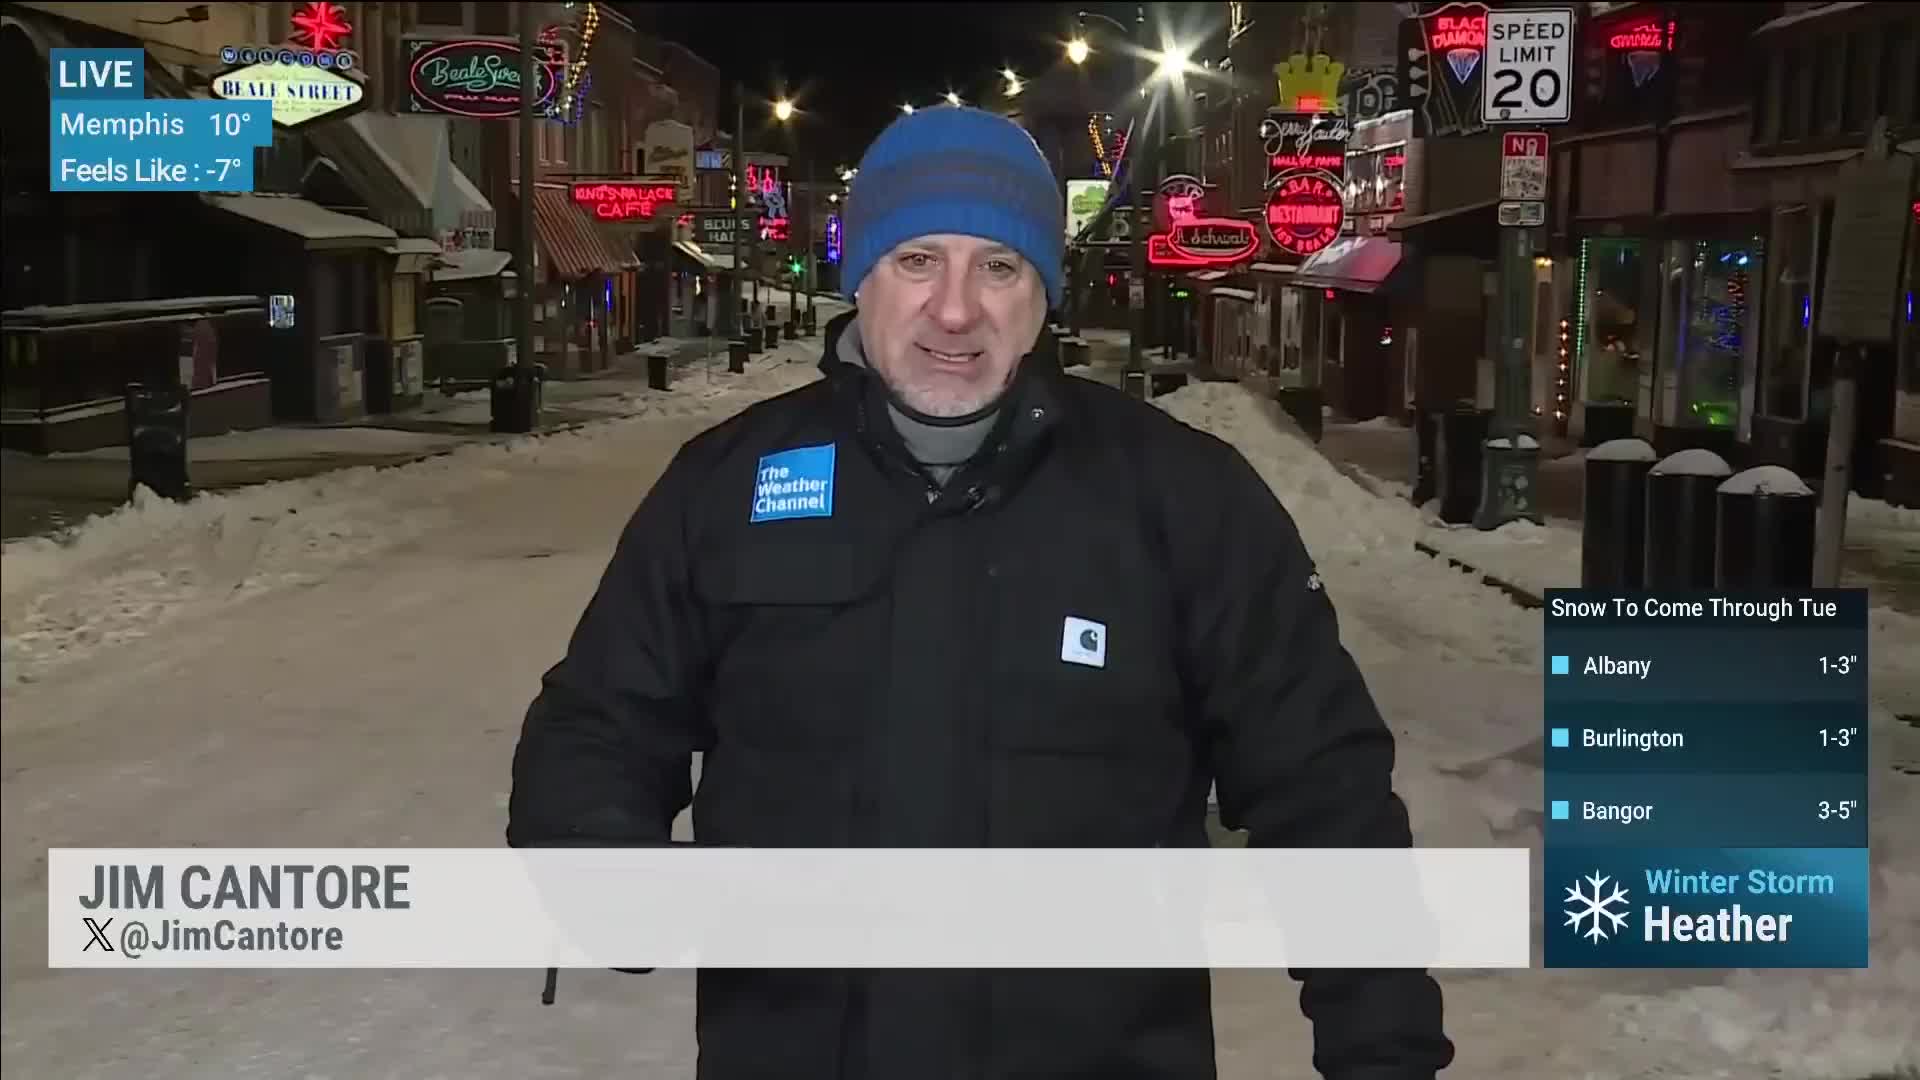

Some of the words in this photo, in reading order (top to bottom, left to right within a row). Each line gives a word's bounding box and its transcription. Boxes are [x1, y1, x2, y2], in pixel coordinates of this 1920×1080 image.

[1438, 16, 1485, 30] BLAC
[1493, 23, 1565, 40] SPEED
[1432, 30, 1485, 48] DIAMON
[221, 47, 352, 70] WELCOME
[1500, 46, 1556, 63] LIMIT
[420, 56, 486, 86] Beale
[223, 81, 277, 97] BEALE
[287, 84, 355, 100] STREET
[1492, 69, 1561, 108] 20
[1273, 157, 1298, 166] HALL
[620, 187, 673, 201] PALACE
[1288, 178, 1325, 194] BAR
[1269, 205, 1340, 225] RESTAURANT
[760, 465, 790, 482] The
[758, 477, 829, 497] Weather
[755, 493, 825, 513] Channel
